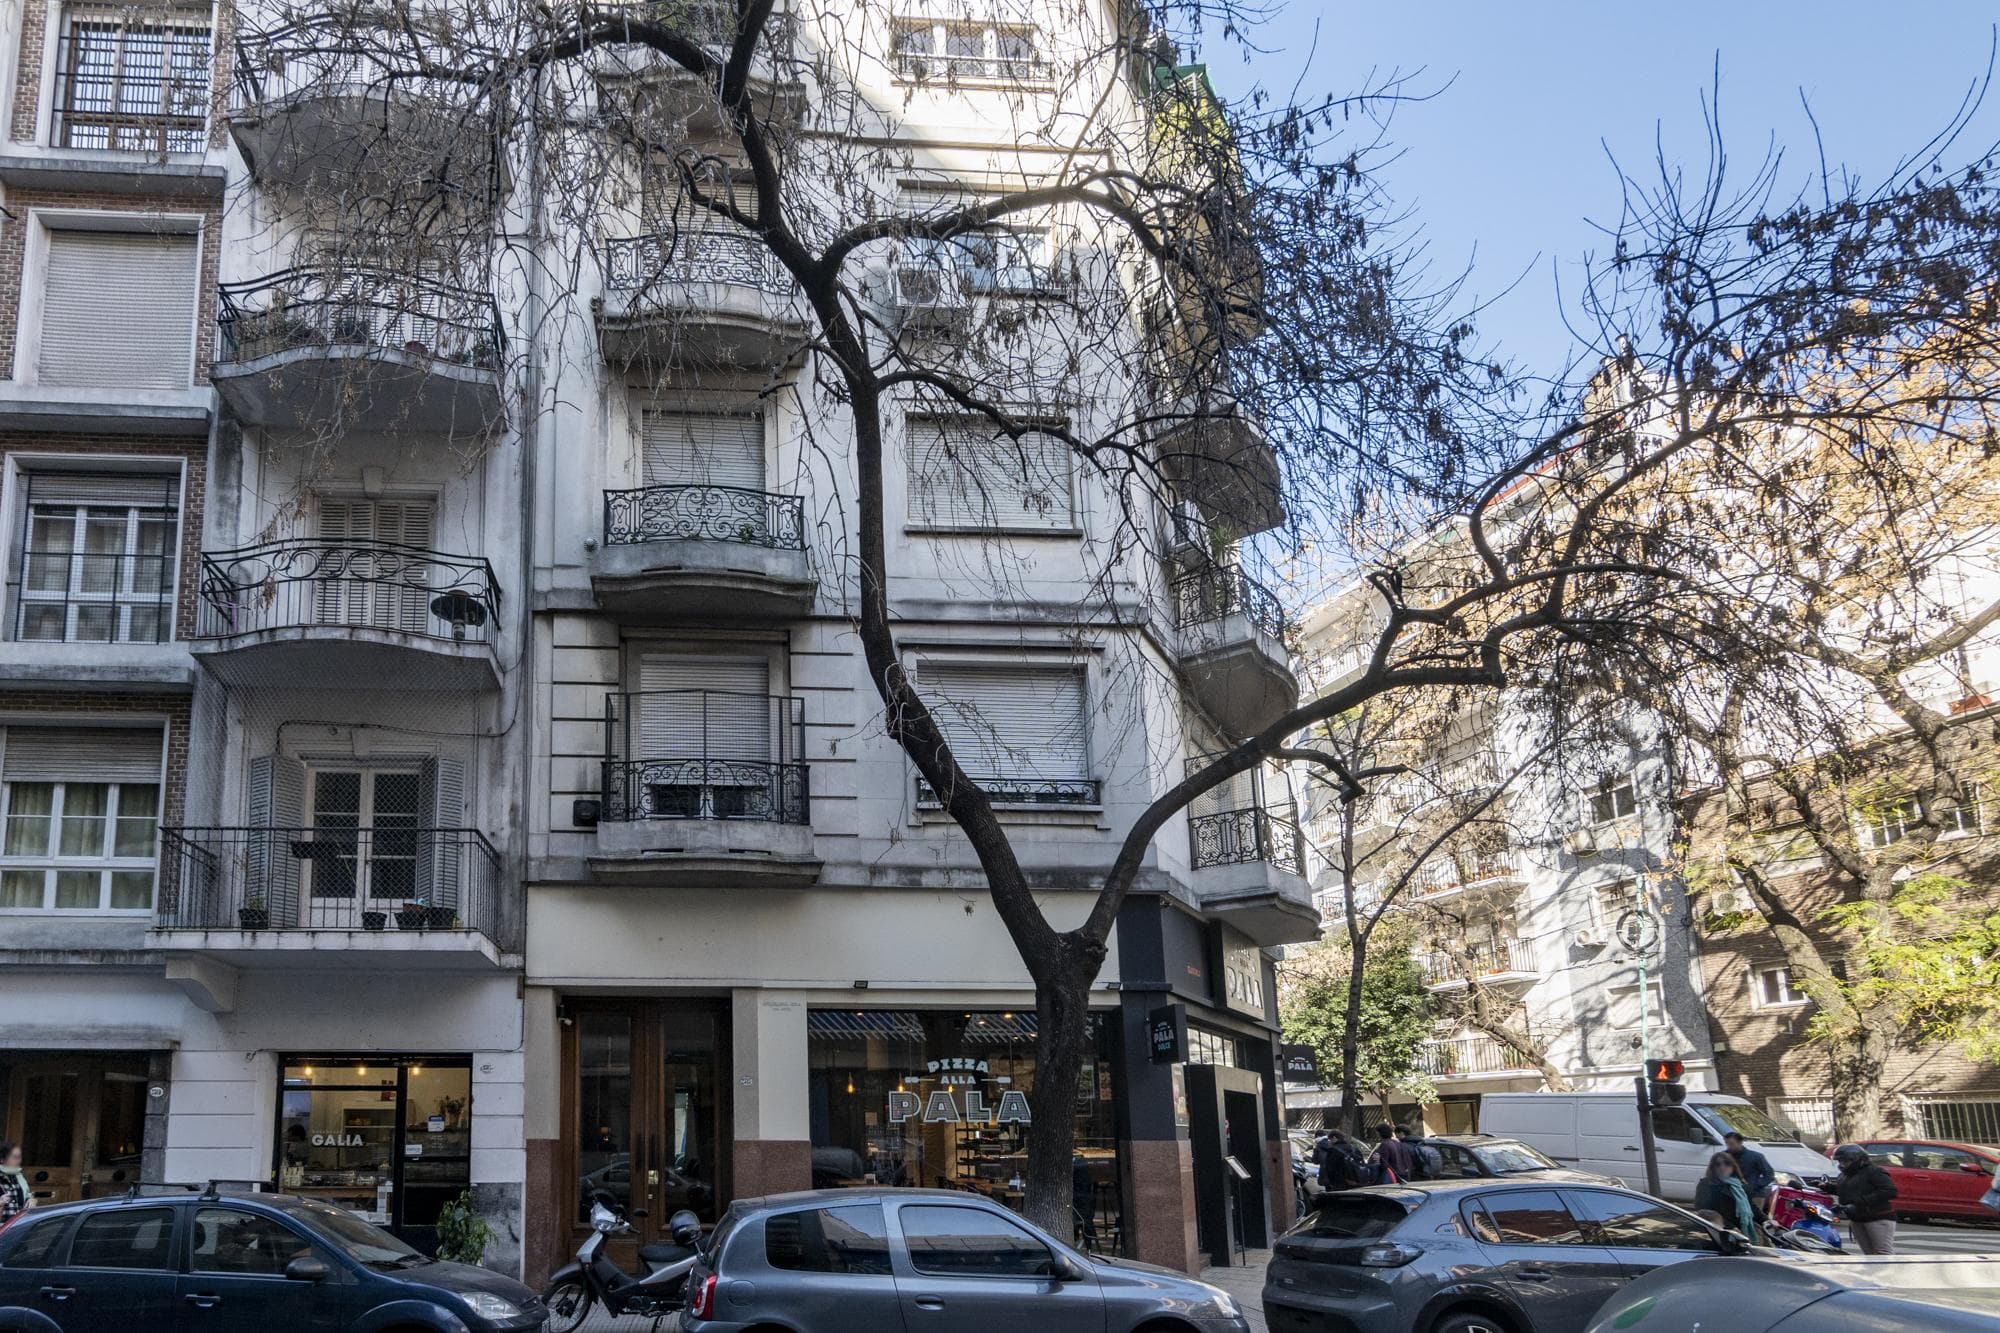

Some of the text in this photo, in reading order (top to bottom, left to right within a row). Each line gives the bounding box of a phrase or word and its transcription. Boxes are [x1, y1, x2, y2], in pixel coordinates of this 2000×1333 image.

[1154, 1030, 1174, 1043] PALA
[927, 1058, 989, 1073] PIZZA
[1287, 1062, 1313, 1070] PALA
[940, 1075, 976, 1084] ALLA
[889, 1091, 1032, 1122] PALA
[312, 1134, 363, 1146] GALIA
